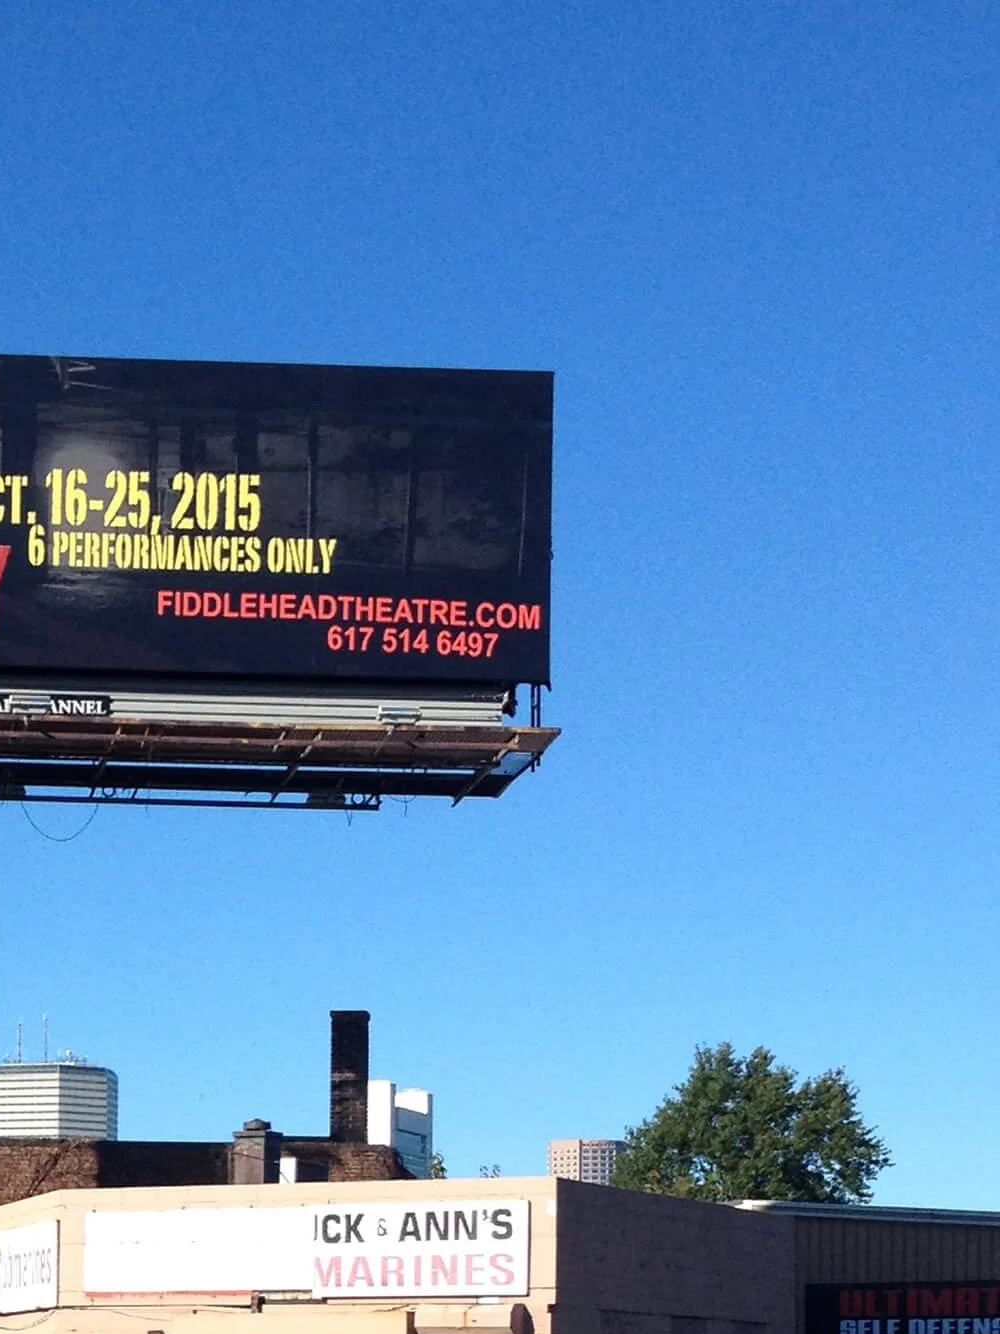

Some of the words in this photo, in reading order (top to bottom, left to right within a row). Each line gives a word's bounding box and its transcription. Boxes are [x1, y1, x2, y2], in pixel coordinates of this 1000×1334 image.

[45, 467, 161, 536] 16-25,
[170, 471, 261, 532] 2015
[27, 530, 45, 567] 6
[51, 532, 261, 574] PERFORMANCES
[266, 537, 337, 575] ONLY
[157, 590, 541, 631] FIDDLEHEADTHEATRE.COM
[327, 624, 374, 653] 617
[382, 626, 430, 655] 514
[435, 629, 499, 659] 6497
[376, 1217, 388, 1237] &
[398, 1208, 514, 1242] ANN'S
[314, 1253, 515, 1288] MARINES
